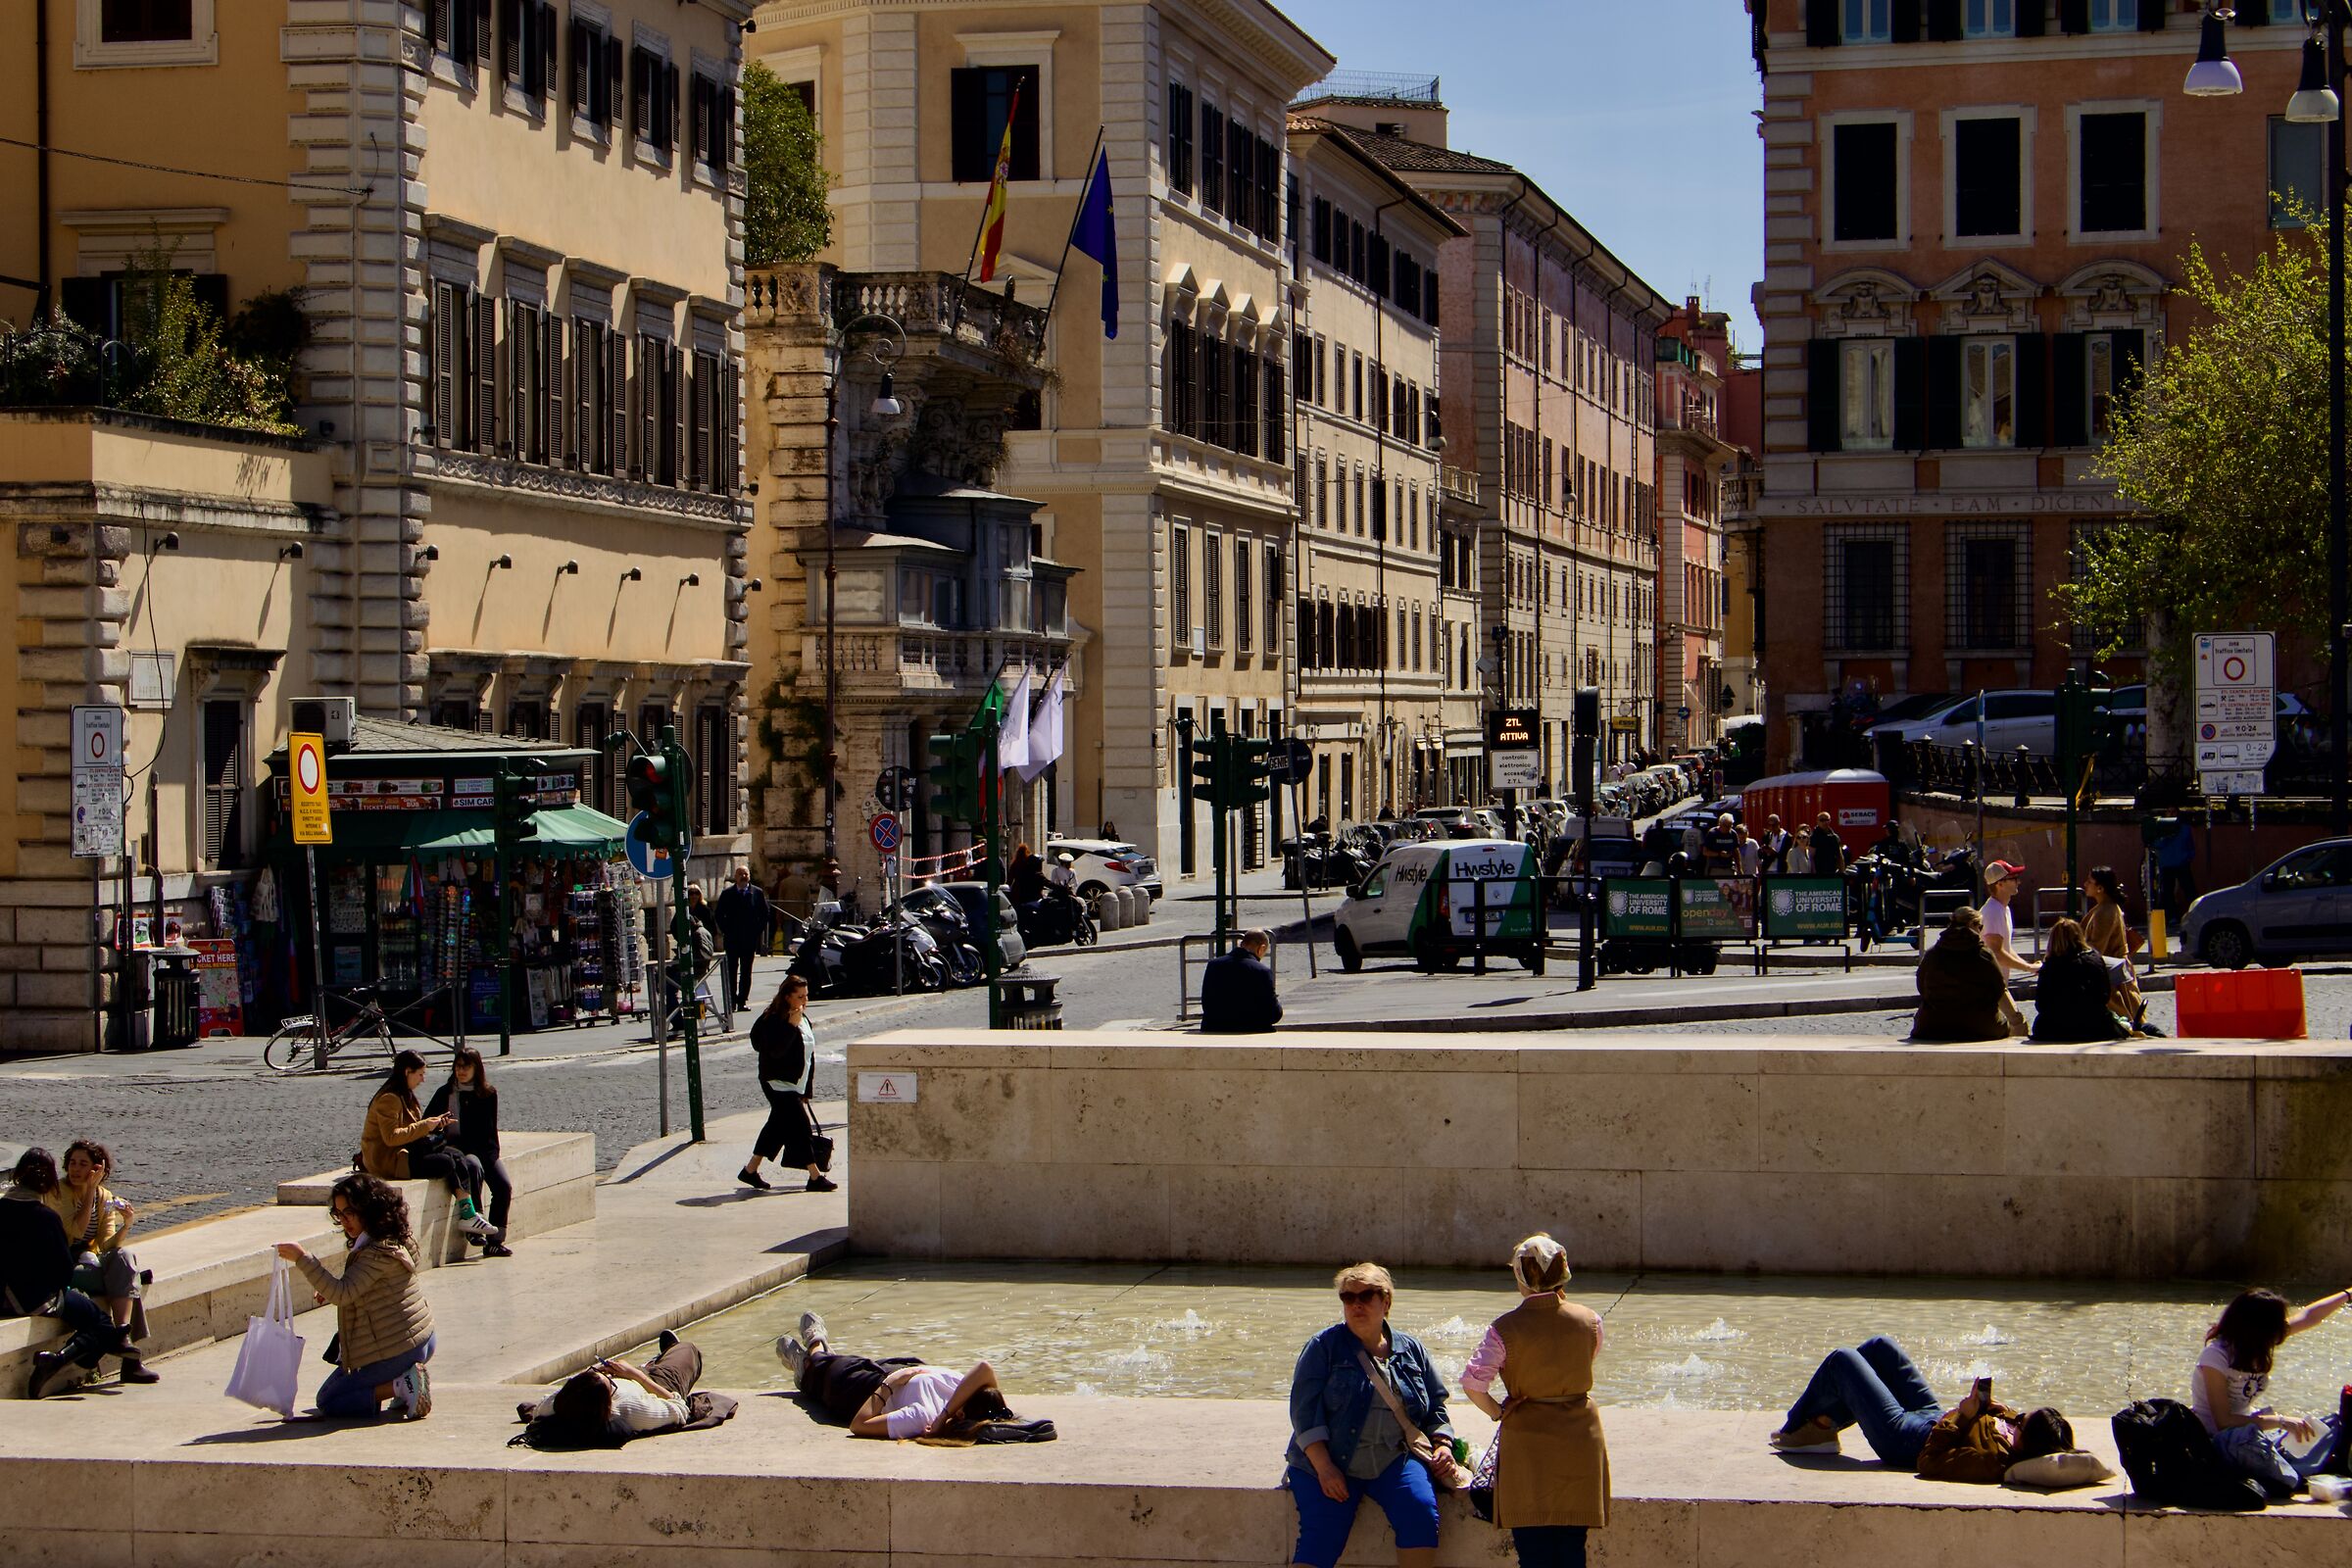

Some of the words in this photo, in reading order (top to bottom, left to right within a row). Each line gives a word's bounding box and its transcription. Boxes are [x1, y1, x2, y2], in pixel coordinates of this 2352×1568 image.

[1796, 497, 1922, 514] SALVTATE
[1951, 497, 2001, 513] EAM
[2031, 494, 2137, 512] DICENTE
[1505, 718, 1522, 727] ZTL
[1499, 732, 1529, 741] ATTIVA
[2258, 743, 2268, 752] 24
[1454, 858, 1516, 878] Hwstyle
[1396, 861, 1428, 886] Hwstyle
[1629, 906, 1642, 915] OF
[1642, 906, 1668, 915] ROME
[1795, 903, 1810, 912] OF
[1811, 903, 1842, 911] ROME
[1682, 907, 1728, 918] openday
[190, 954, 215, 963] TCKET
[217, 953, 236, 962] HERE
